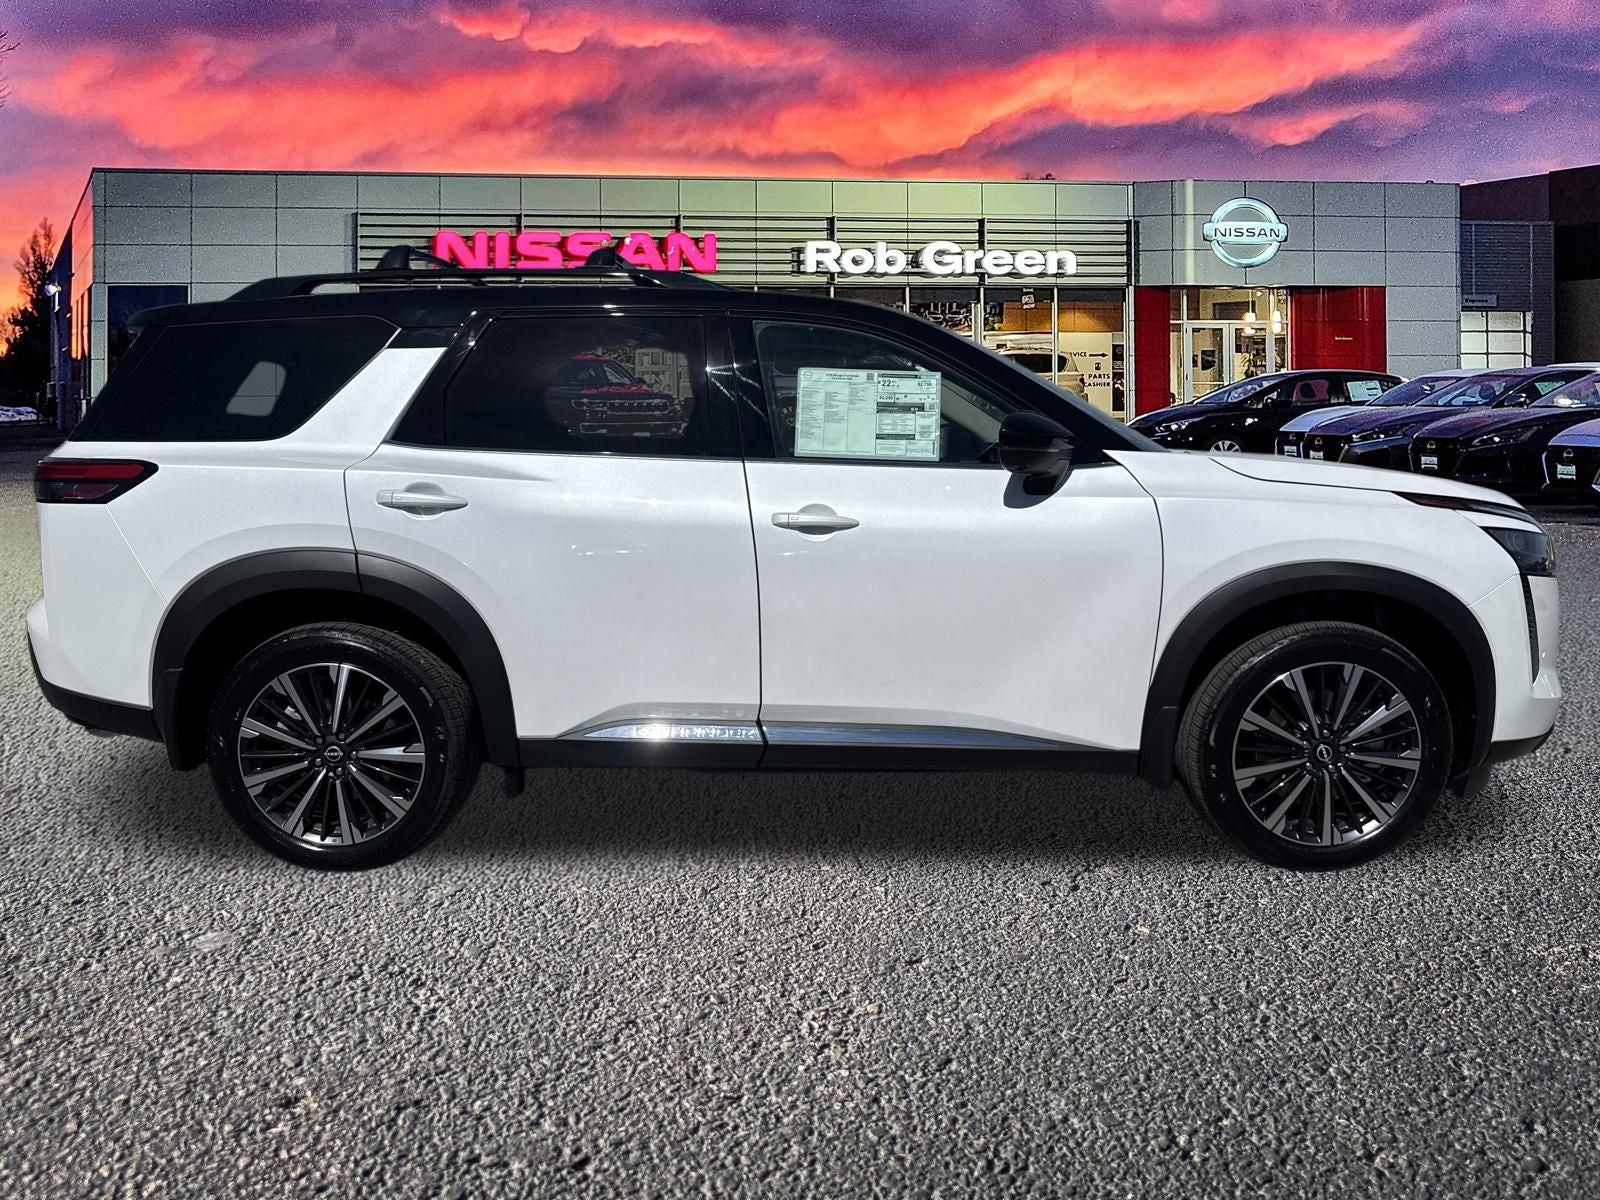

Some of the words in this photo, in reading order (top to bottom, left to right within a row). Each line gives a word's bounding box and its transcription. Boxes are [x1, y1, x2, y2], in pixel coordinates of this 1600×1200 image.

[1214, 227, 1280, 238] NISSAN
[433, 230, 718, 273] NISSAN
[805, 240, 906, 275] Rob
[922, 240, 1078, 275] Green
[881, 379, 891, 387] 22
